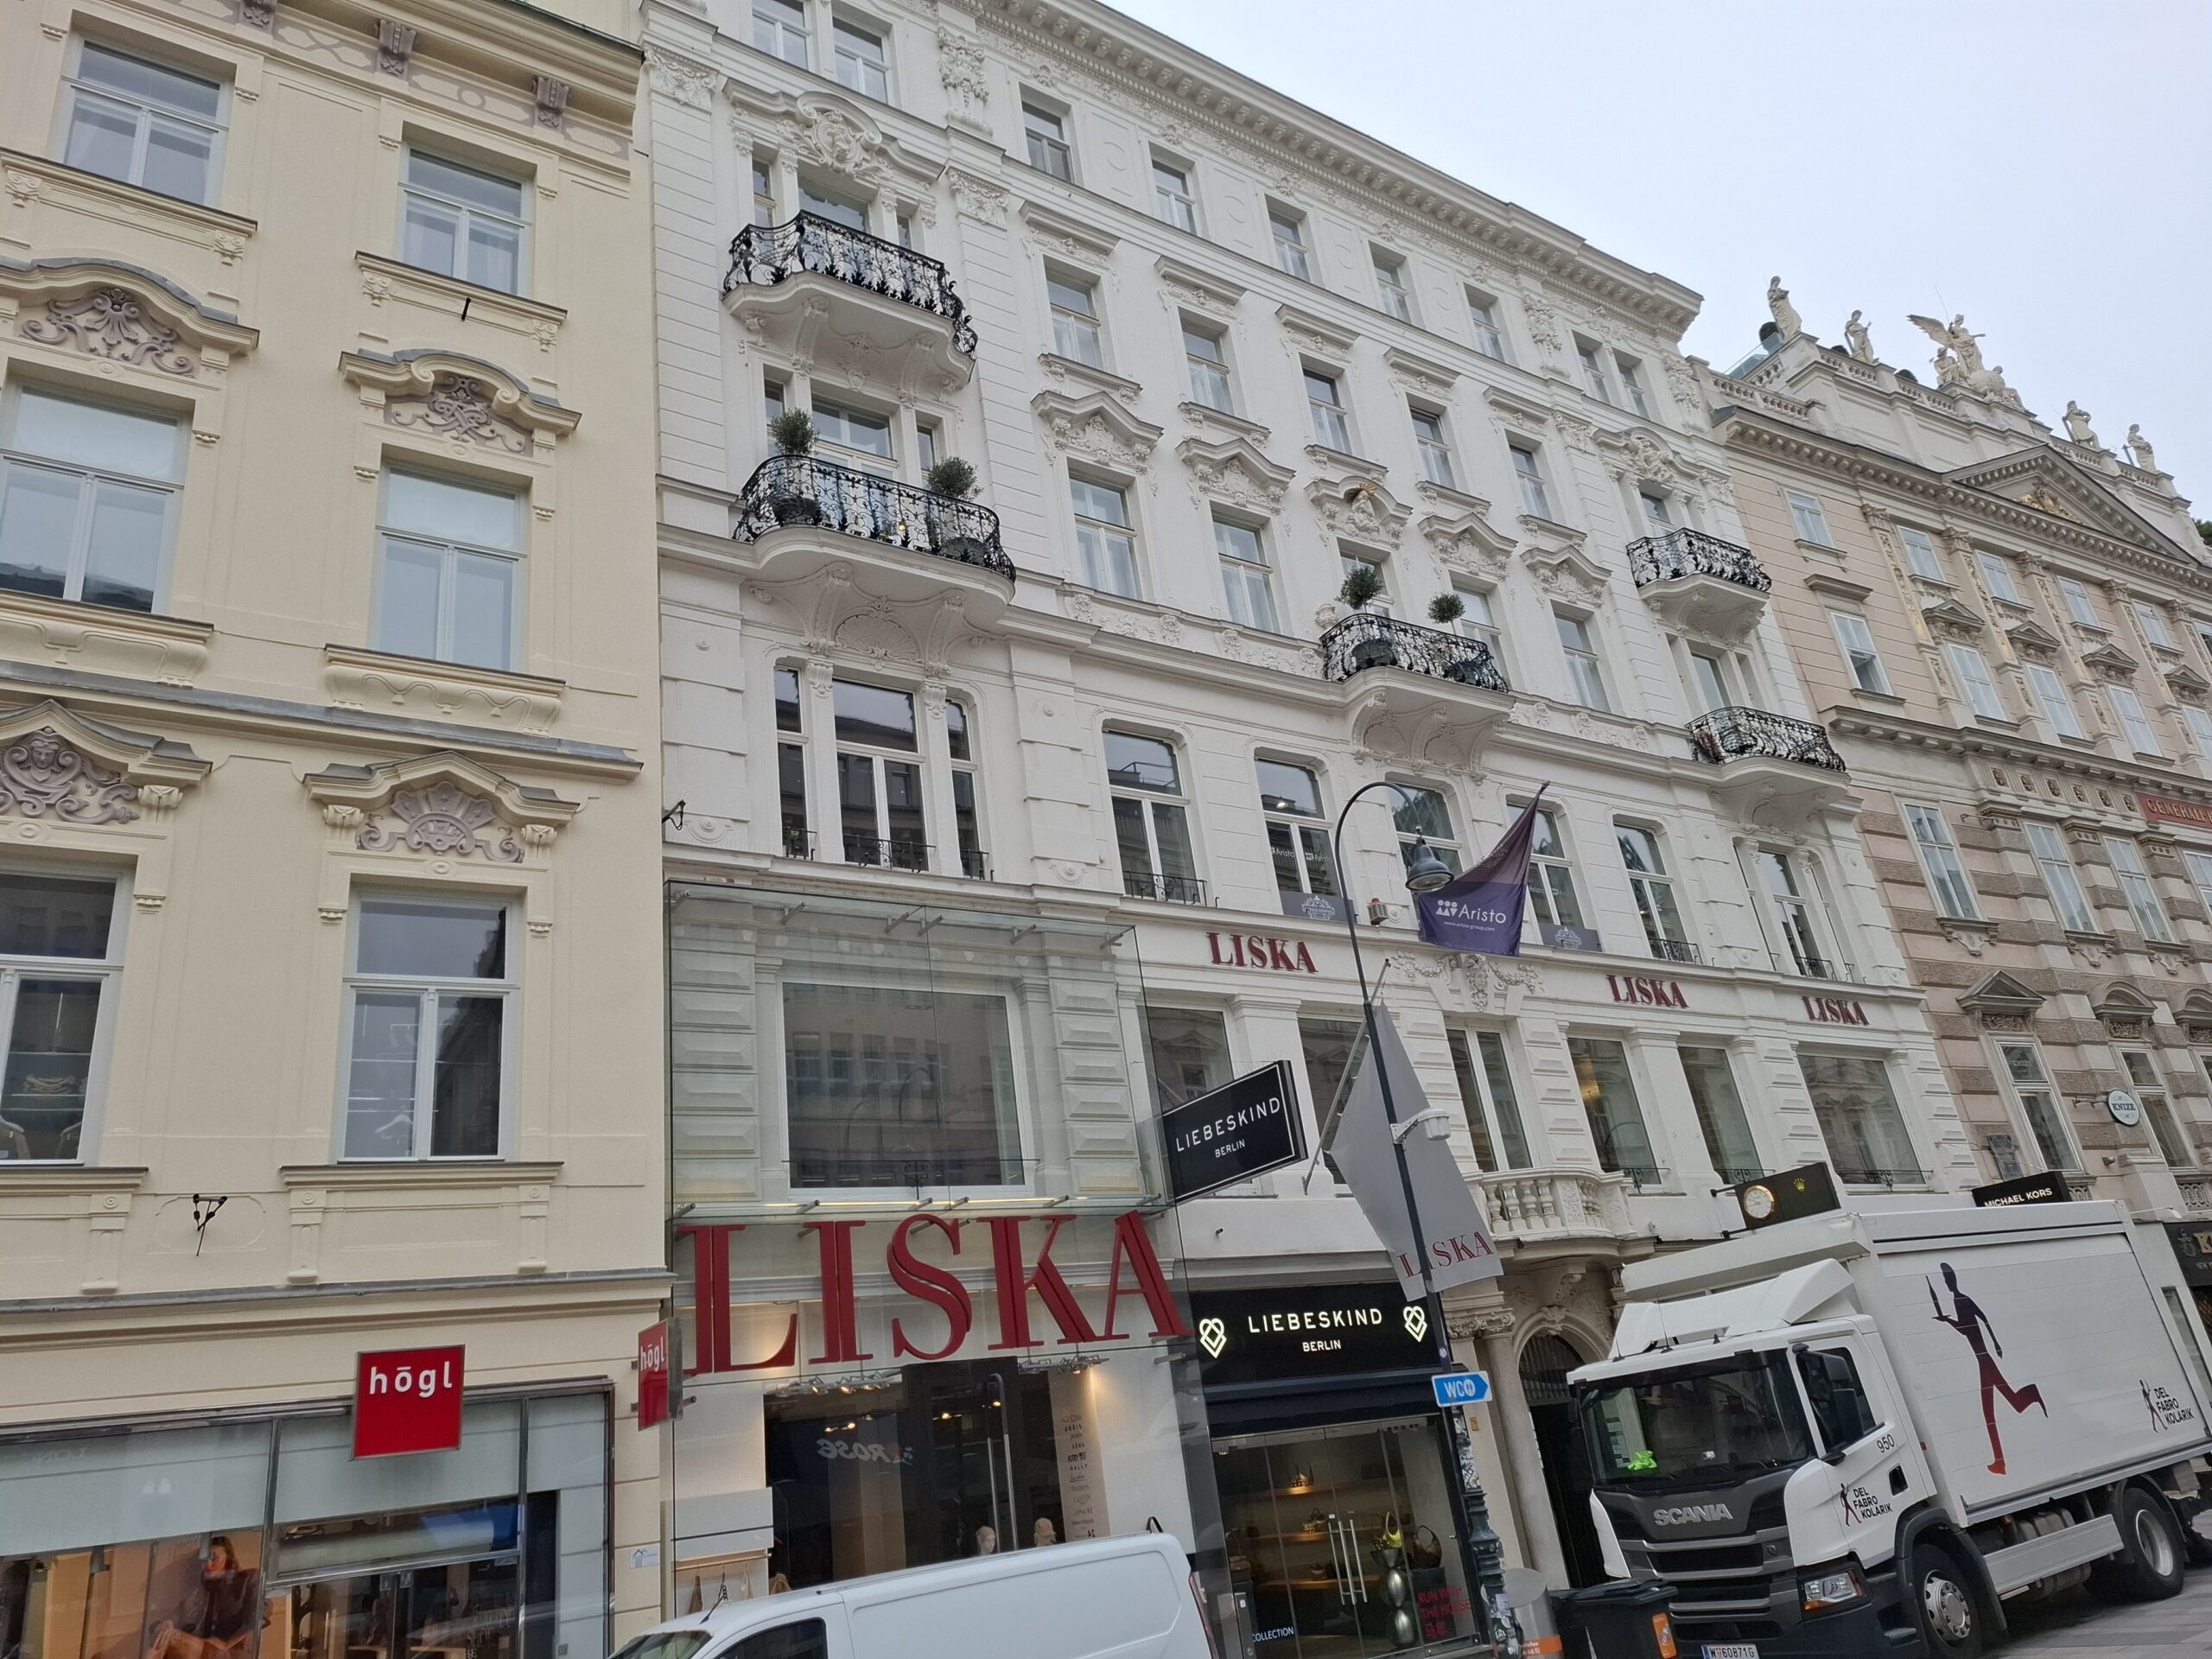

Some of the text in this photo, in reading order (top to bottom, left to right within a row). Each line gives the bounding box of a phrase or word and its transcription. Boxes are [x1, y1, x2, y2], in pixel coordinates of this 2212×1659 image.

[1458, 903, 1506, 924] Aristo
[1206, 931, 1319, 973] LISKA
[1606, 975, 1688, 1008] LISKA
[1802, 995, 1870, 1026] LISKA
[2111, 1103, 2136, 1111] KNIZE
[1176, 1097, 1280, 1152] LIEBESKIND
[1215, 1139, 1245, 1158] BERLIN
[1984, 1188, 2052, 1207] MICHAEL KORS
[1396, 1231, 1493, 1279] LSKA
[676, 1210, 1195, 1375] LISKA
[1248, 1308, 1382, 1333] LIEBESKIND
[1302, 1339, 1341, 1352] BERLIN
[2154, 1387, 2170, 1399] DEL
[2156, 1397, 2179, 1413] FABRO
[2164, 1408, 2195, 1425] KOLARIK
[1877, 1434, 1895, 1452] 950
[1853, 1487, 1869, 1498] DEL
[1853, 1496, 1878, 1510] FABRO
[1860, 1503, 1893, 1519] KOLARIK
[1654, 1503, 1733, 1526] SCANIA
[1418, 1591, 1438, 1604] RUN
[1421, 1608, 1438, 1618] THE
[1710, 1647, 1755, 1657] W 60871G
